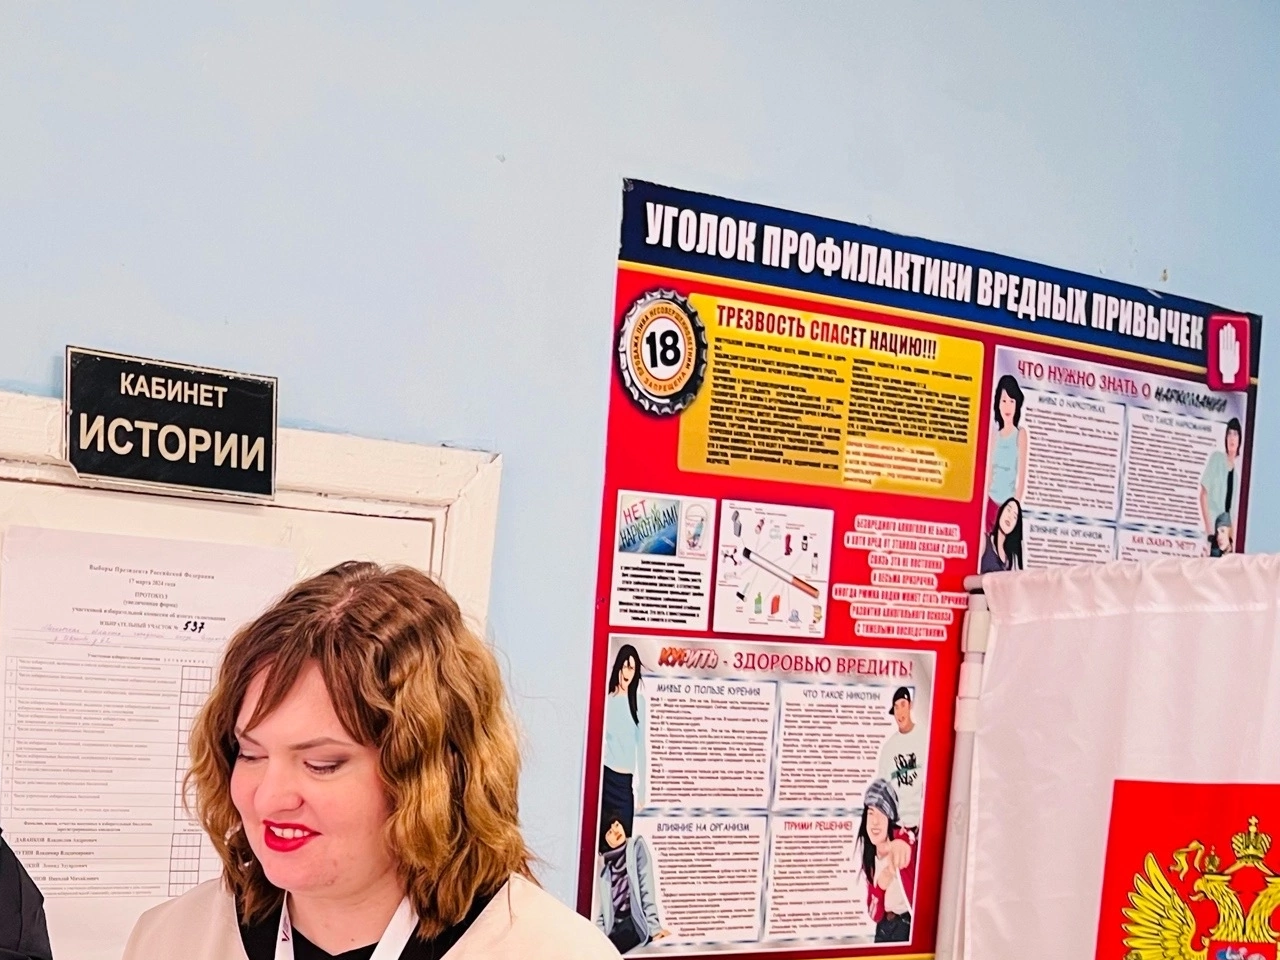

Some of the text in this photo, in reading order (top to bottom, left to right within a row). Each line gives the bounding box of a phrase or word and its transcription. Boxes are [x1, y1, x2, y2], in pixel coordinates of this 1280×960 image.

[645, 201, 1204, 350] УГОЛОК ПРОФИЛАКТИКИ ВРЕДНЫХ ПРИВЫЧЕК
[646, 330, 681, 368] 18
[717, 304, 937, 360] ТРЕЗВОСТЬ СПАСЕТ НАЦИЮ!!!
[120, 372, 228, 408] КАБИНЕТ
[1018, 360, 1044, 380] ЧТО
[1048, 365, 1096, 387] НУЖНО
[1099, 374, 1138, 396] ЗНАТЬ
[1142, 382, 1151, 399] О
[79, 412, 265, 471] ИСТОРИИ
[623, 499, 648, 525] НЕТ
[733, 652, 831, 674] ЗДОРОВЬЮ
[836, 657, 913, 678] ВРЕДИТЬ!
[803, 689, 818, 698] ЧТО
